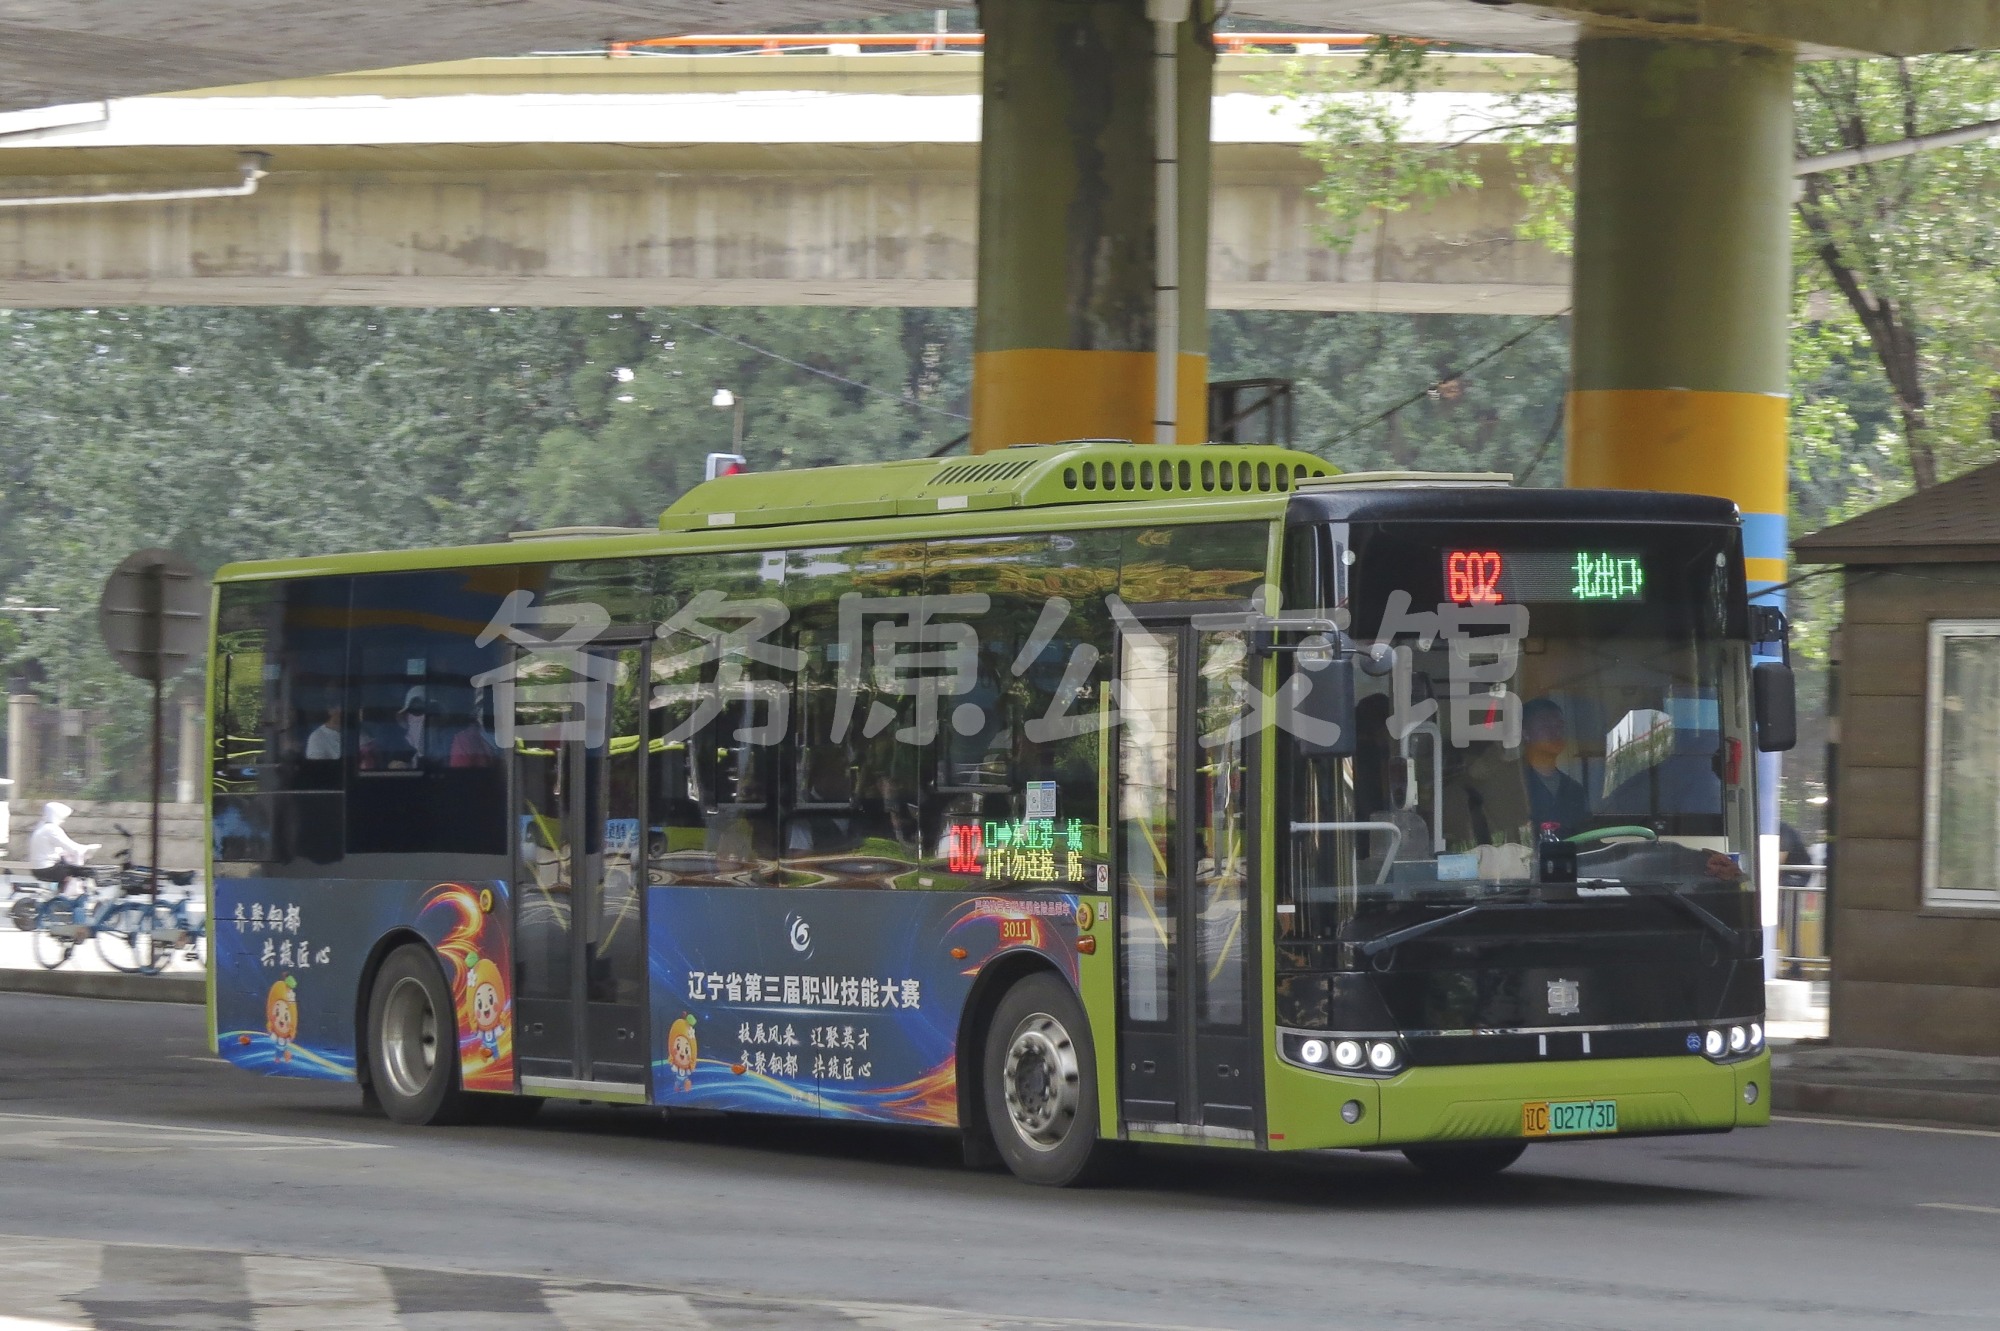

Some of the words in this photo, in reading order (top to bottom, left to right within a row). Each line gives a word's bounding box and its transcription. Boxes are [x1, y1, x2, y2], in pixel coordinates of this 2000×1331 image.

[1449, 552, 1503, 602] 602
[1571, 552, 1638, 599] 北出口
[949, 824, 982, 873] 602
[1003, 921, 1028, 938] 3011
[261, 938, 331, 968] 共筑匠心
[688, 971, 921, 1009] 辽宁省第三届职业技能大赛
[738, 1022, 800, 1047] 技展风采
[810, 1026, 870, 1050] 辽聚英才
[811, 1054, 872, 1081] 共筑匠心
